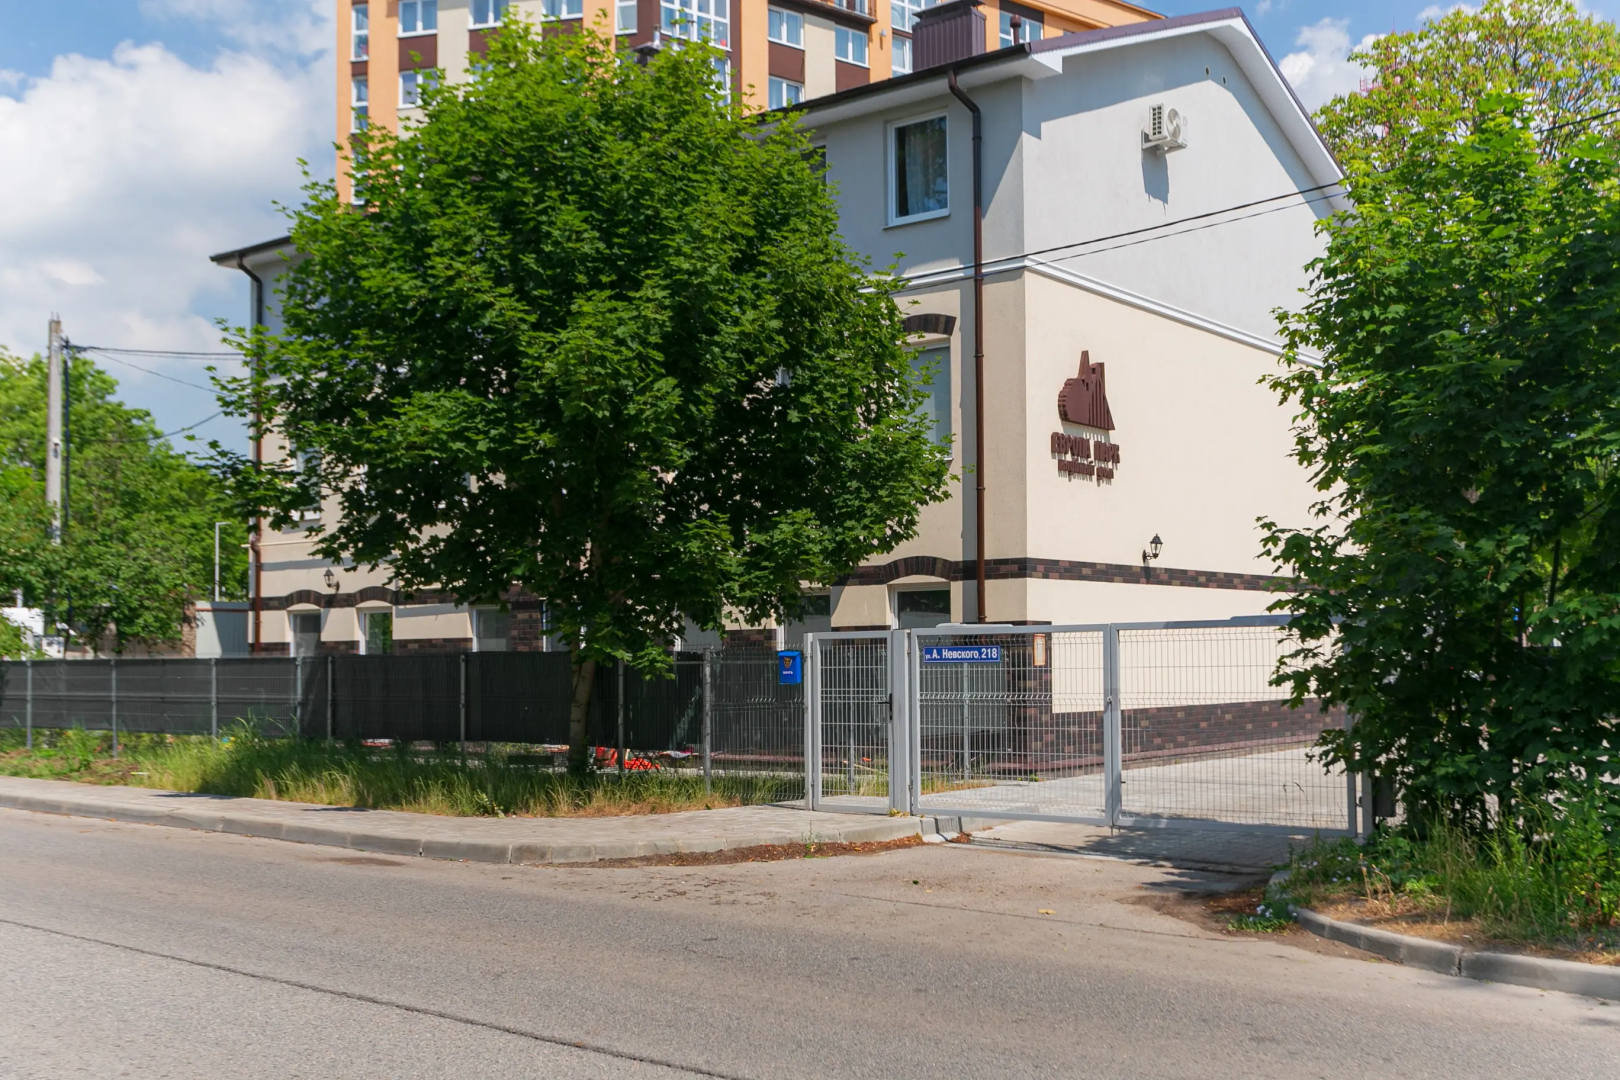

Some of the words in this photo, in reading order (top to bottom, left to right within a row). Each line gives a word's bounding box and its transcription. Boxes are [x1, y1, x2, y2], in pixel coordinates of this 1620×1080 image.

[1051, 432, 1091, 458] ЕВРОПА
[1094, 440, 1120, 463] ПАРК
[932, 649, 940, 659] А.
[942, 648, 980, 660] Невского,
[981, 648, 998, 659] 218
